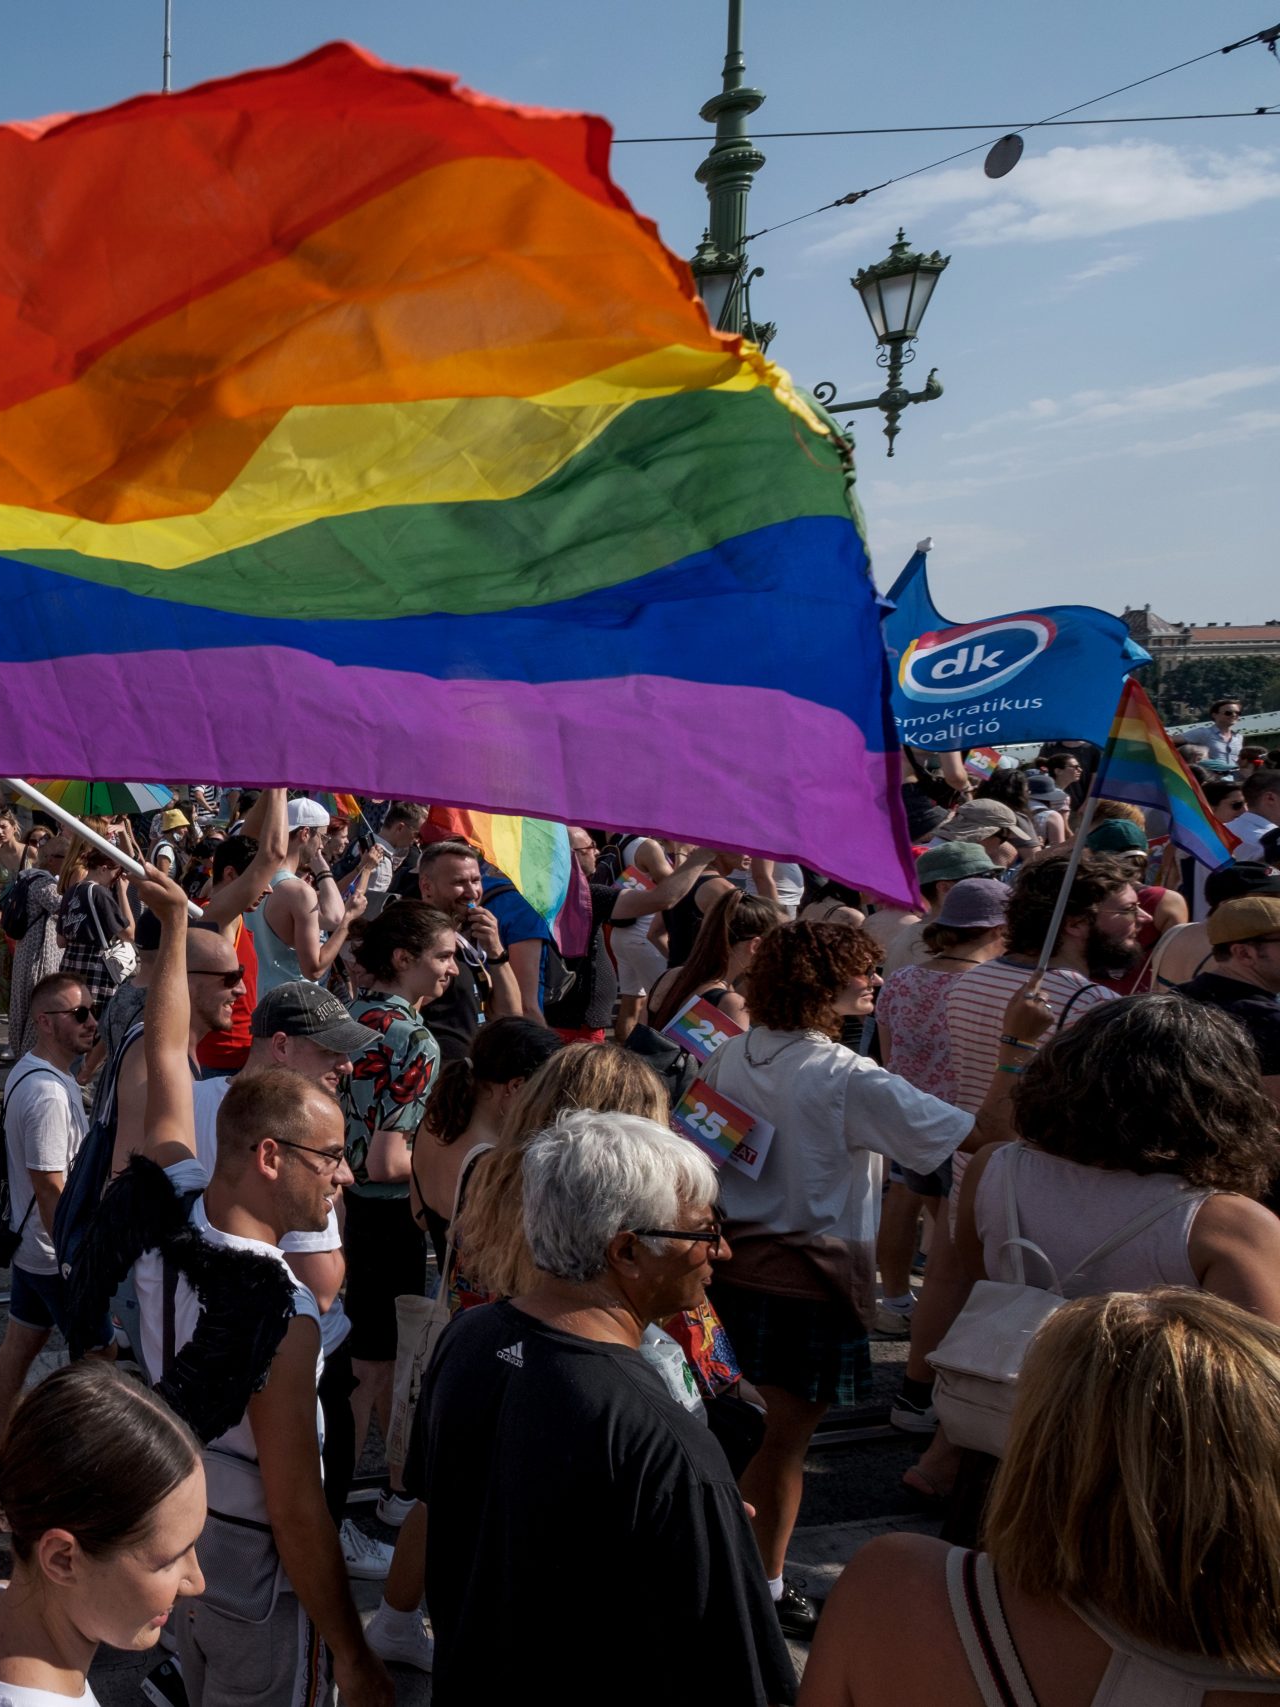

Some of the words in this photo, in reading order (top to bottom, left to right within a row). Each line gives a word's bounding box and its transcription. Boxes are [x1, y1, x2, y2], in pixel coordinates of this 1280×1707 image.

[931, 645, 1004, 680] dk
[893, 697, 1043, 728] emokratikus
[904, 717, 1000, 745] Koalíció
[969, 752, 992, 769] 25
[687, 1019, 729, 1053] 25
[685, 1102, 728, 1139] 25
[496, 1350, 524, 1368] adidas
